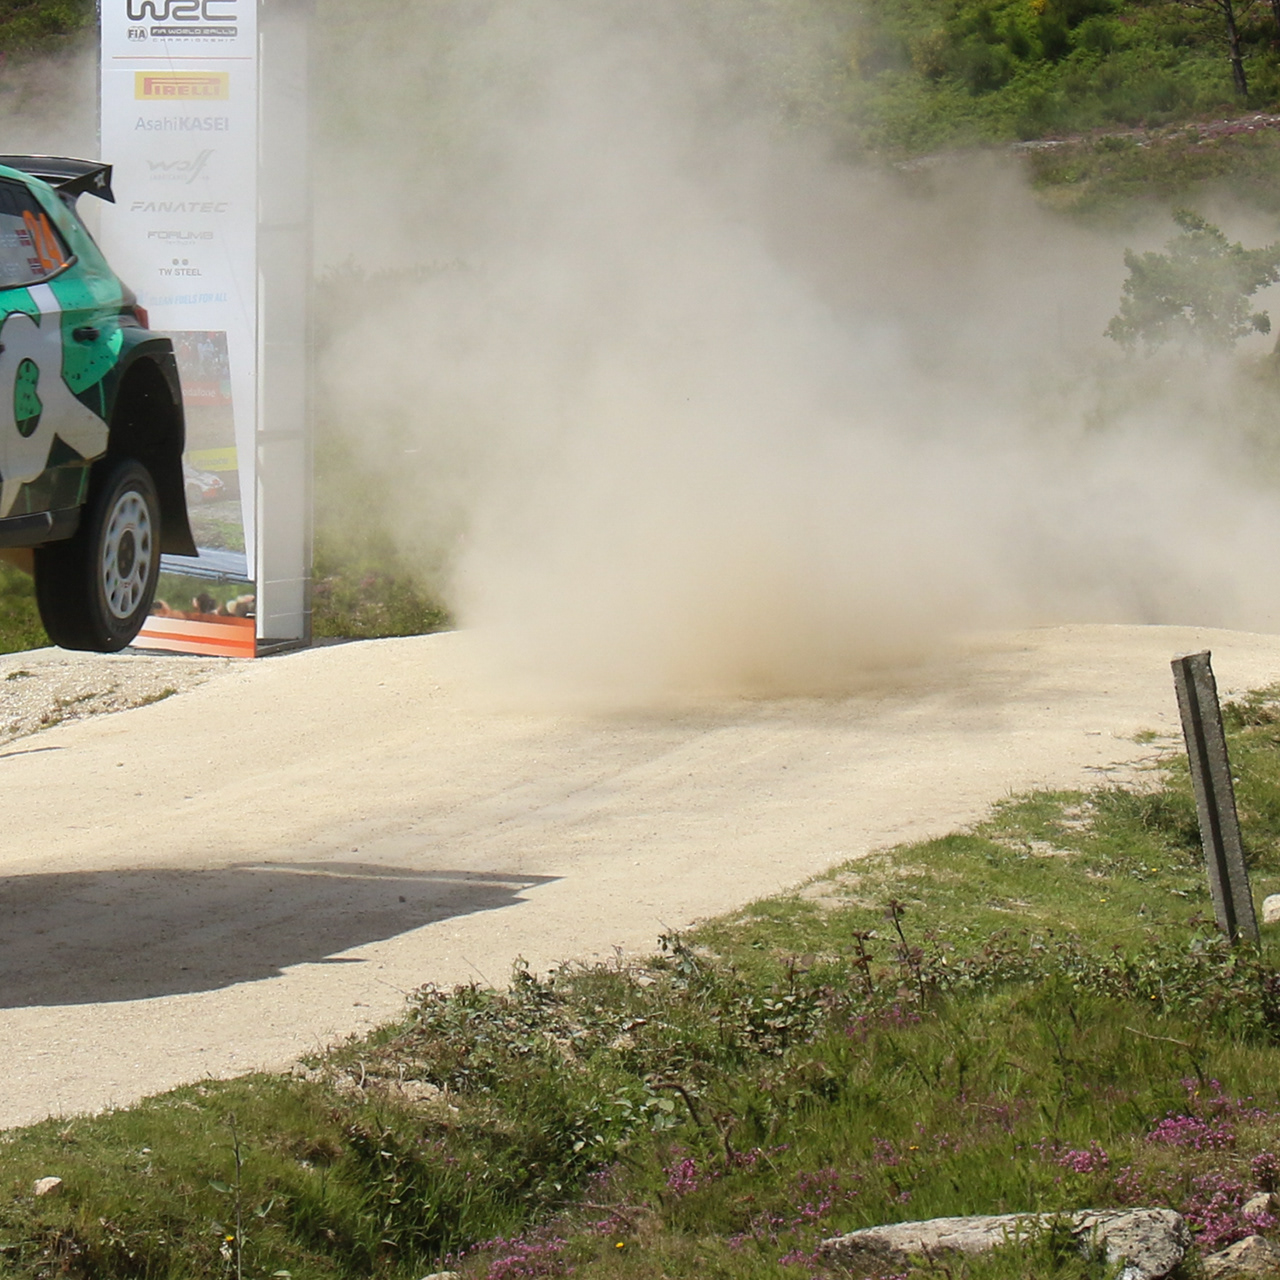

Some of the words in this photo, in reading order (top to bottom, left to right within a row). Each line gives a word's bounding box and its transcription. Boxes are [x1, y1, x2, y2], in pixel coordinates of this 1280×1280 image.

[127, 29, 146, 40] FIA
[144, 77, 221, 96] PIRELLI
[134, 117, 230, 131] AsahiKASEI
[130, 201, 229, 213] FANATEC
[159, 268, 172, 276] TW
[174, 268, 202, 276] STEEL
[174, 294, 198, 305] FUELS
[198, 293, 214, 304] FOR
[214, 292, 228, 303] ALL
